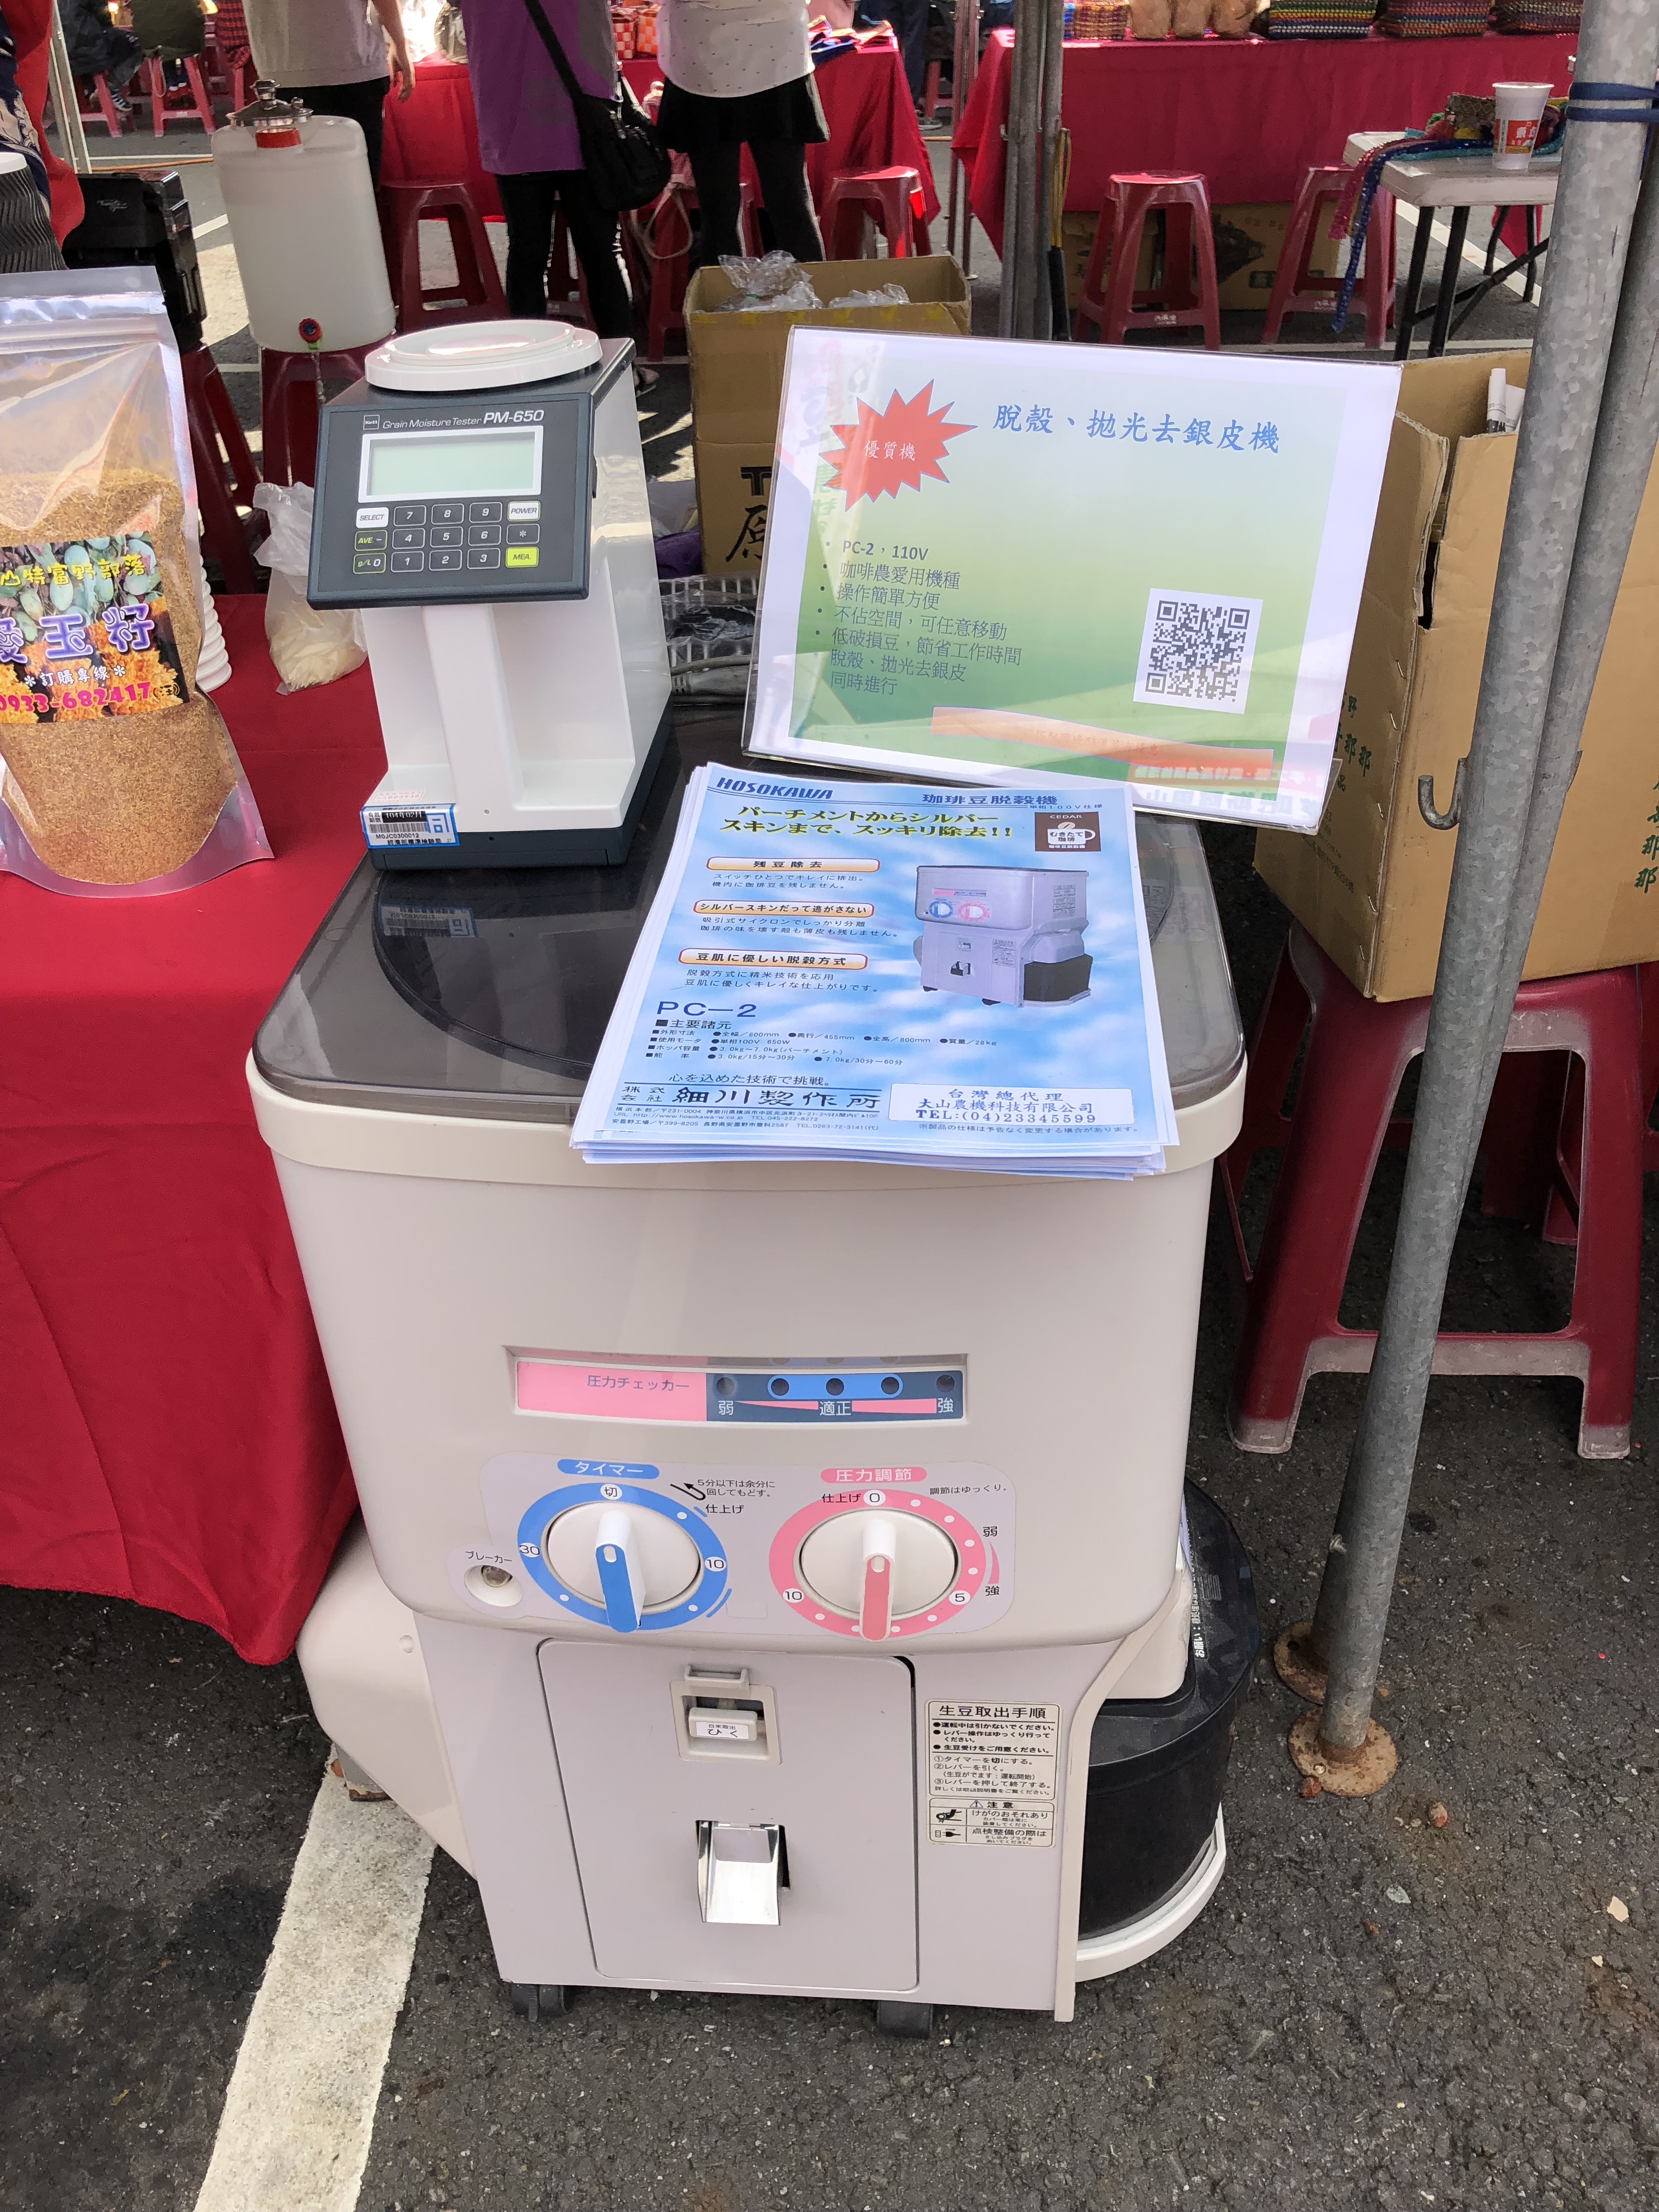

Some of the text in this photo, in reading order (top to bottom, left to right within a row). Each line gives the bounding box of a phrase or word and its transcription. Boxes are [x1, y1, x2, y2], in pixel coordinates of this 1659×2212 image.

[382, 421, 408, 429] Grain
[409, 418, 451, 428] Moisture
[453, 417, 482, 426] Tester
[483, 410, 544, 424] PM-650
[864, 439, 916, 461] 優質機
[360, 514, 384, 522] SELECT
[444, 510, 451, 518] 8
[482, 508, 489, 516] 9
[511, 506, 537, 515] POWER
[405, 534, 412, 543] 4
[443, 532, 450, 540] 5
[481, 531, 488, 539] 6
[373, 558, 381, 567] 0
[405, 557, 410, 566] 1
[442, 556, 449, 564] 2
[480, 554, 487, 562] 3
[840, 561, 961, 590] 咖啡農愛用機種
[837, 583, 941, 611] 操作簡單方便
[834, 606, 1007, 641] 不佔空間，可任意移動
[832, 627, 1022, 666] 低破損豆，節省工作時間
[40, 667, 110, 686] 訂購專線
[831, 672, 898, 695] 同時進行
[0, 681, 151, 712] 0933-682417
[716, 777, 833, 800] HOSOKAWA
[922, 794, 1058, 805] 珈琲豆脱穀機
[738, 806, 999, 823] パーチメントからシルバー
[700, 903, 867, 914] シルバースキンだって逃がさない
[702, 917, 866, 927] 吸引式サイクロンでしっかり分離
[696, 953, 847, 966] 豆肌に優しい脱穀方式
[669, 1019, 732, 1030] 主要諸元
[669, 1074, 829, 1086] 心を込めた技術で挑戦。
[672, 1086, 881, 1109] 細川製作所
[949, 1088, 1064, 1102] 台灣總代理
[918, 1098, 1093, 1114] 大山農機科技有限公司
[587, 1374, 955, 1417] 圧力チェッカー 弱 適正 強
[574, 1462, 644, 1476] タイマー
[836, 1468, 912, 1482] 圧力調節
[698, 1479, 776, 1488] 5分以下は余分に
[929, 1484, 1007, 1495] 調節はゆっくり。
[604, 1486, 618, 1499] 切
[707, 1488, 770, 1497] 回してもどす。
[821, 1493, 881, 1503] 仕上げ 0
[706, 1504, 745, 1514] 仕上げ
[983, 1526, 998, 1537] 弱
[519, 1545, 540, 1555] 30
[465, 1550, 512, 1564] ブレーカー
[706, 1559, 724, 1570] 10
[784, 1590, 804, 1601] 10
[985, 1585, 1000, 1596] 強
[955, 1593, 966, 1602] 5
[939, 1705, 1047, 1719] 生豆取出手順
[941, 1722, 1054, 1731] 運転中は引かないでください。
[944, 1730, 1050, 1739] レバー操作はゆっくり行って
[944, 1745, 1049, 1753] 生豆受けをご用意ください。
[972, 1810, 1048, 1820] けがのおそれあり
[972, 1828, 1046, 1837] 点検整備の際は
